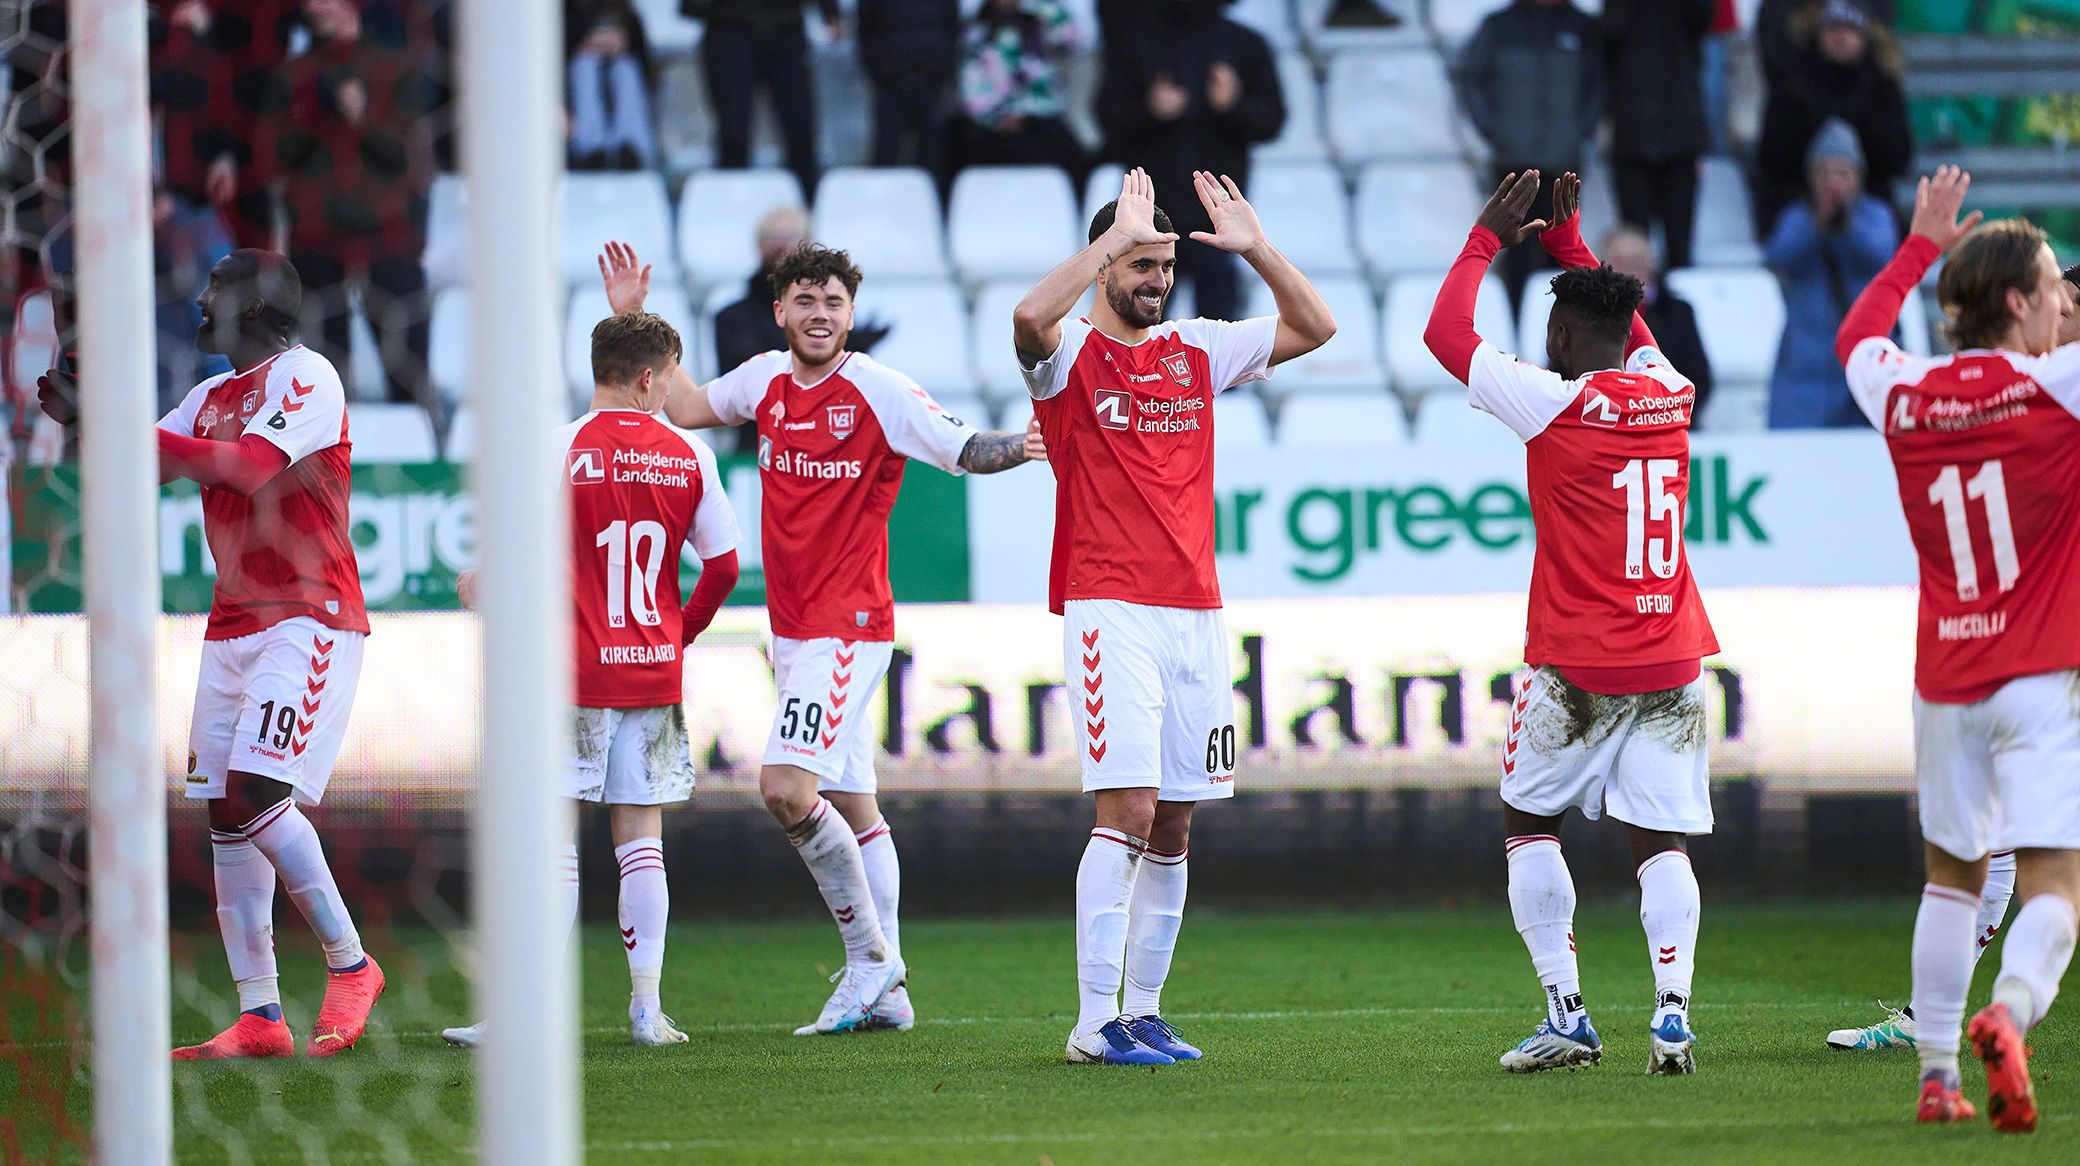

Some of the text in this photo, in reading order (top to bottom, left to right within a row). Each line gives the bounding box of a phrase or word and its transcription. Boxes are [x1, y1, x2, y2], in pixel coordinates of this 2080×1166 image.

[1137, 416, 1201, 434] Landsbank
[612, 448, 698, 472] Arbejdernes
[775, 450, 862, 480] al finans
[613, 467, 688, 489] Landsbank
[1612, 458, 1680, 580] 15
[1927, 458, 2021, 603] 11
[596, 520, 667, 628] 10
[1636, 594, 1673, 614] OFORI
[600, 644, 676, 665] KIRKEGAARD
[257, 699, 297, 750] 19
[780, 698, 822, 745] 59
[258, 747, 286, 761] hummel
[1206, 724, 1236, 773] 60
